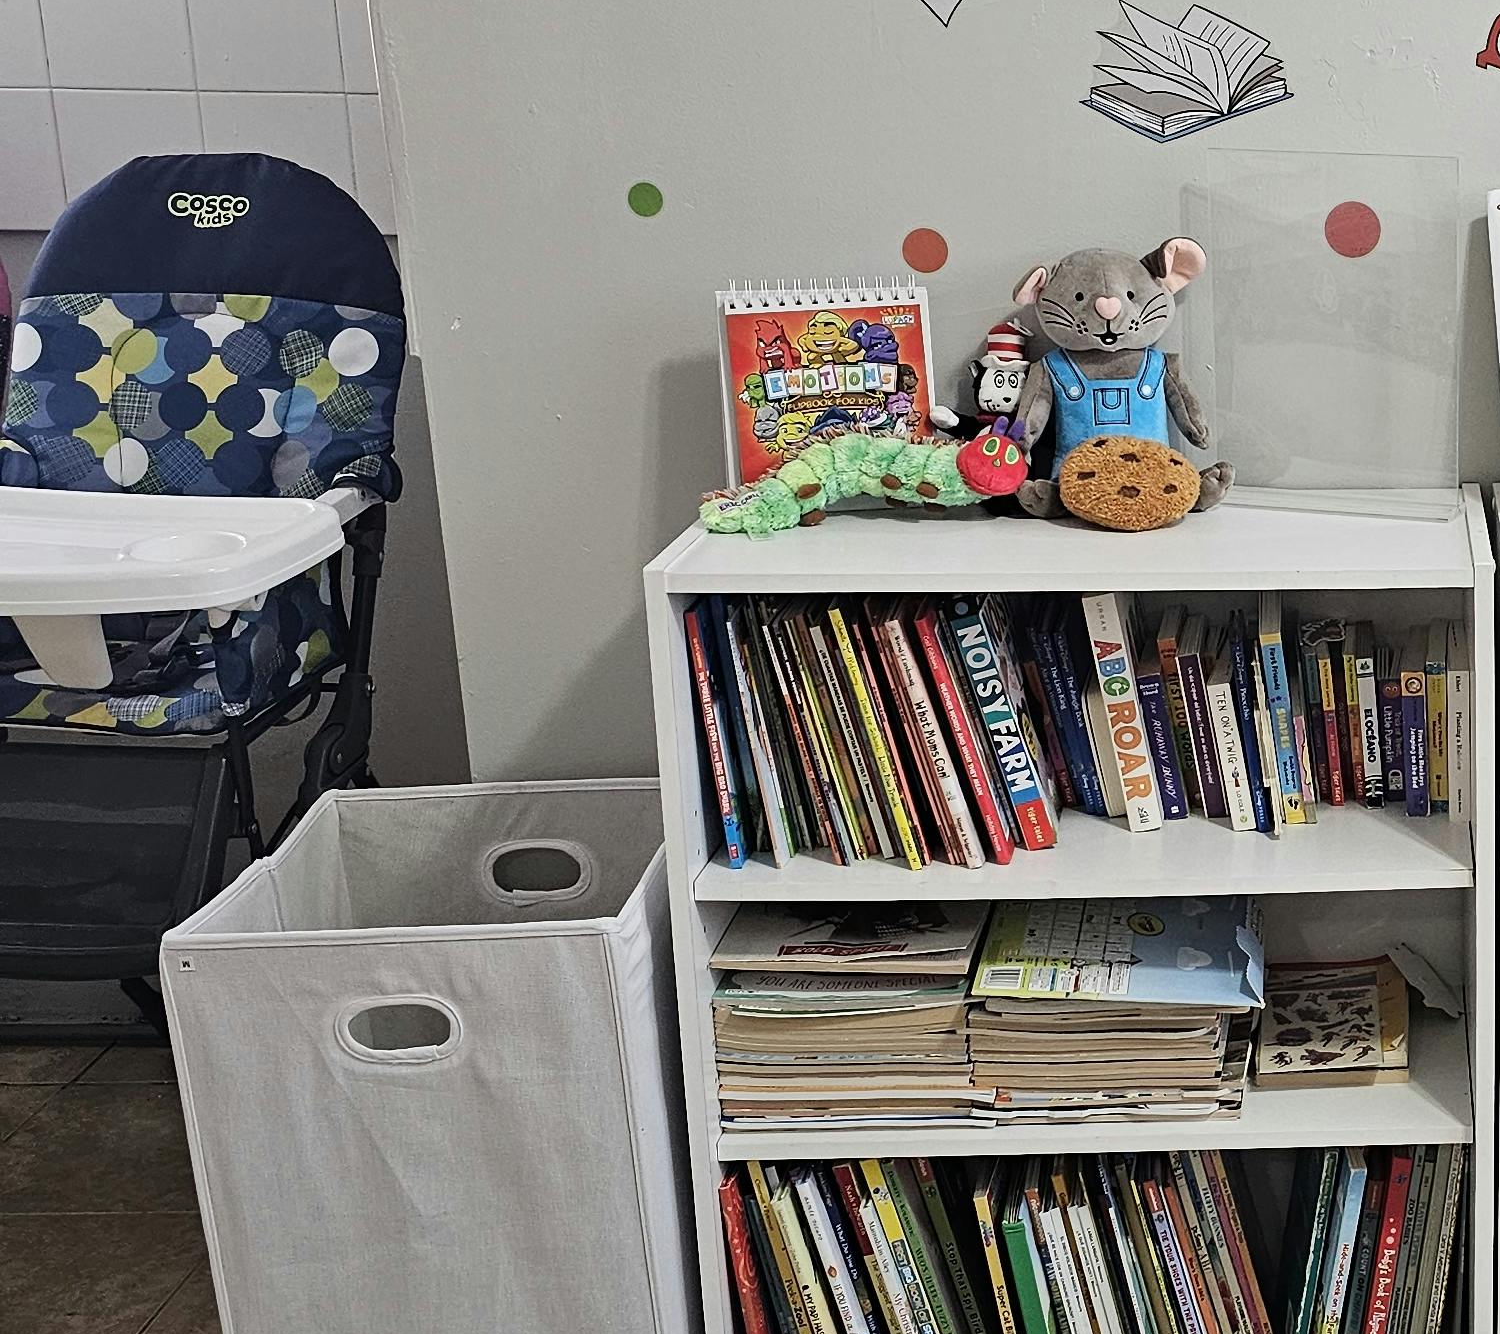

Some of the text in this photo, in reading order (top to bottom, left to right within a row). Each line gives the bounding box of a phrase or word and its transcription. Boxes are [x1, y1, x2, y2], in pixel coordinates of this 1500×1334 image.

[196, 211, 232, 225] kids
[769, 370, 893, 395] EMOTIONS
[788, 397, 881, 413] FLIPBOOK FOR KIDS
[912, 699, 933, 730] What
[955, 621, 1035, 794] NOISY FARM
[1092, 634, 1154, 802] ABC ROAR
[1214, 690, 1238, 764] TEN ON A TWIG
[922, 728, 942, 758] Moms
[755, 974, 939, 991] YOU ARE SOMEONE SPECIAL
[1159, 1229, 1169, 1242] TIE
[891, 1239, 910, 1268] FIRST
[942, 1240, 960, 1267] Stop
[1162, 1242, 1175, 1263] YOUR
[1376, 1247, 1395, 1276] Baby's
[900, 1265, 915, 1284] BIG
[952, 1266, 969, 1292] That
[1169, 1262, 1183, 1287] SHOES
[906, 1282, 925, 1310] BOOK
[1176, 1287, 1189, 1307] WITH
[1375, 1276, 1389, 1298] Book
[801, 1291, 814, 1306] MY
[959, 1291, 976, 1312] Spy
[1330, 1297, 1339, 1308] on
[1374, 1299, 1386, 1309] of
[805, 1304, 820, 1322] PAPI
[916, 1309, 929, 1324] OF
[1182, 1307, 1193, 1323] THE
